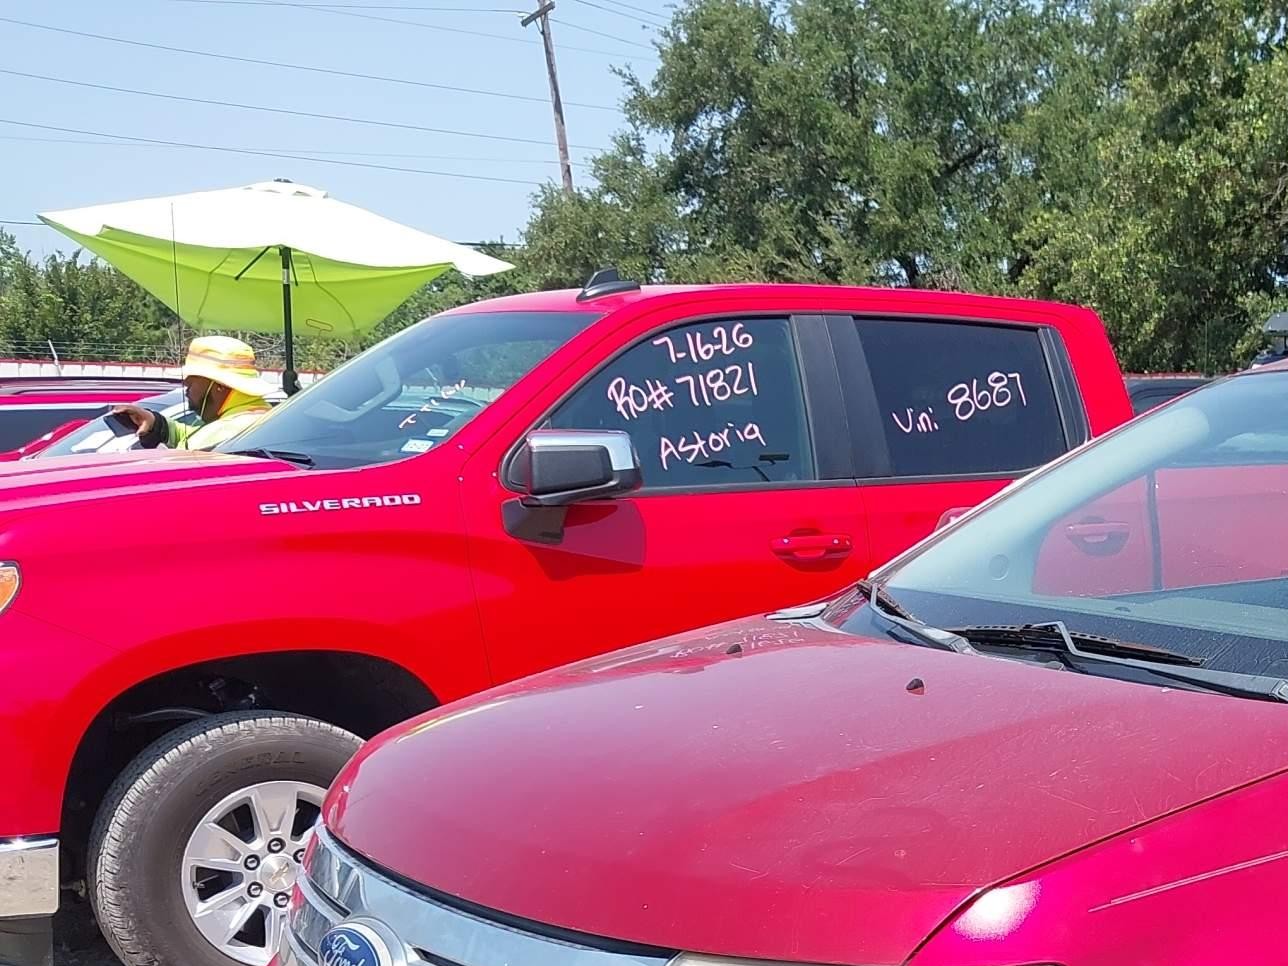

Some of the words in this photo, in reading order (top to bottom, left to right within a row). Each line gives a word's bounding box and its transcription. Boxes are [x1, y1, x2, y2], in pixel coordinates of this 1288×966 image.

[652, 322, 754, 364] 7-16-26
[675, 362, 758, 407] 71821
[947, 371, 1027, 421] 8687
[659, 422, 767, 471] Astoria
[259, 494, 421, 515] SILVERADO
